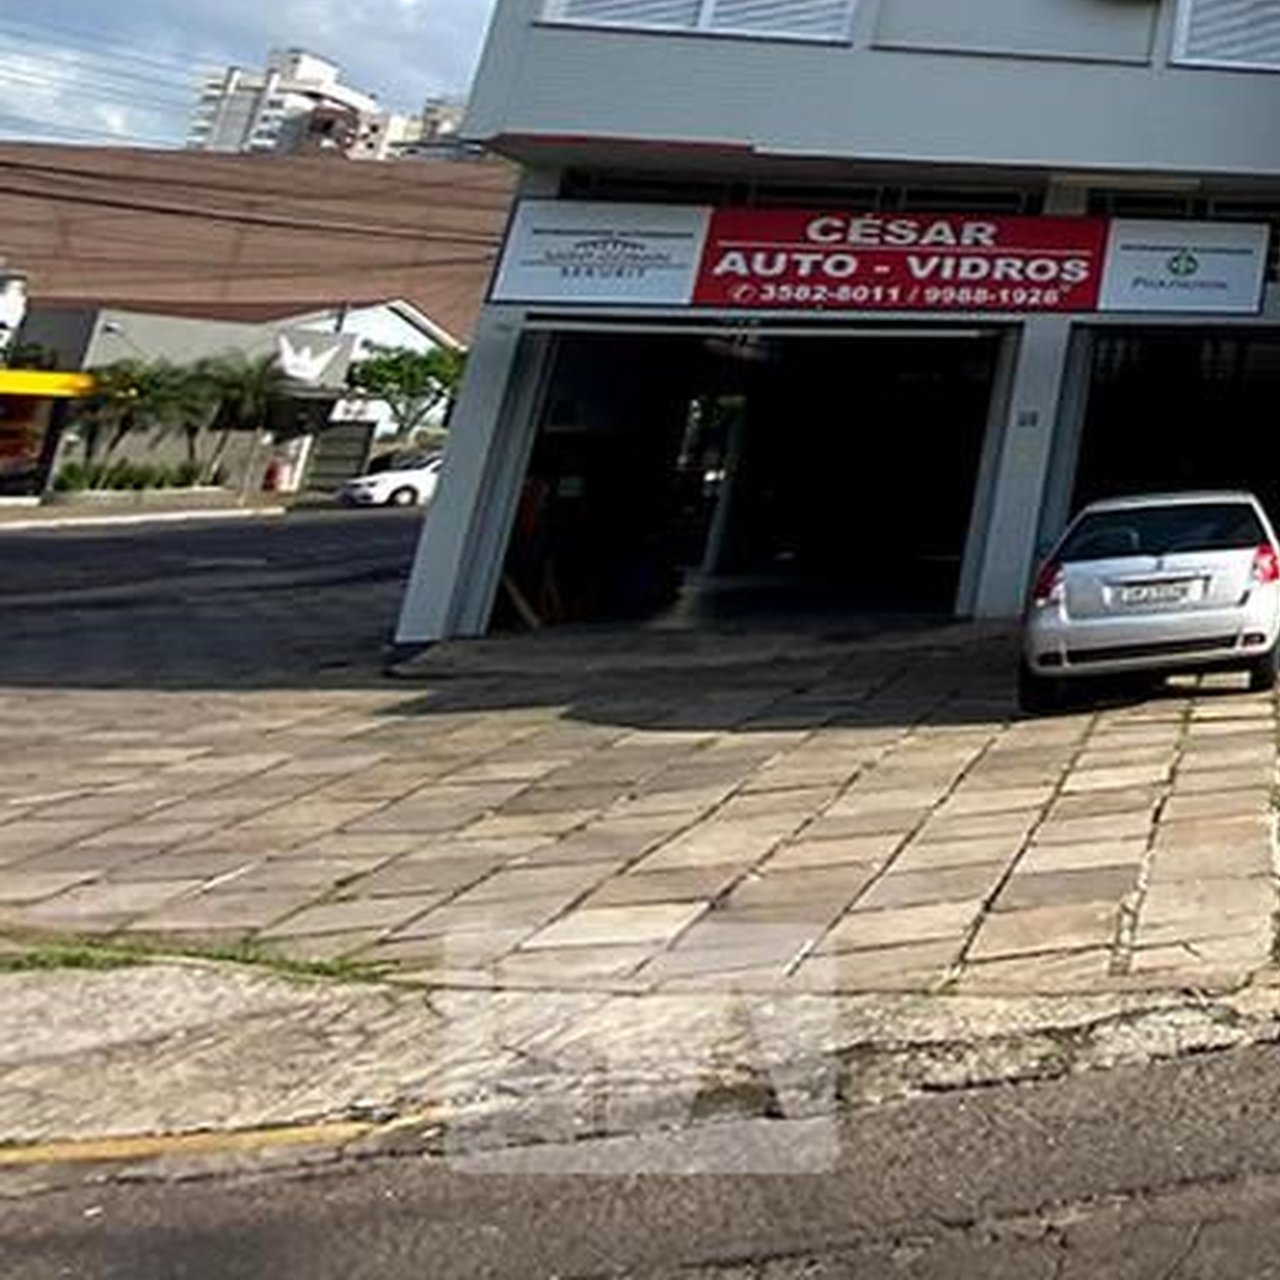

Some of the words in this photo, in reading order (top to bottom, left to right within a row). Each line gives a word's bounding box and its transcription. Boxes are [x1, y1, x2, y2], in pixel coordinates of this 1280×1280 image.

[806, 212, 998, 247] CÉSAR
[712, 250, 859, 279] AUTO
[906, 255, 1090, 283] VIDROS
